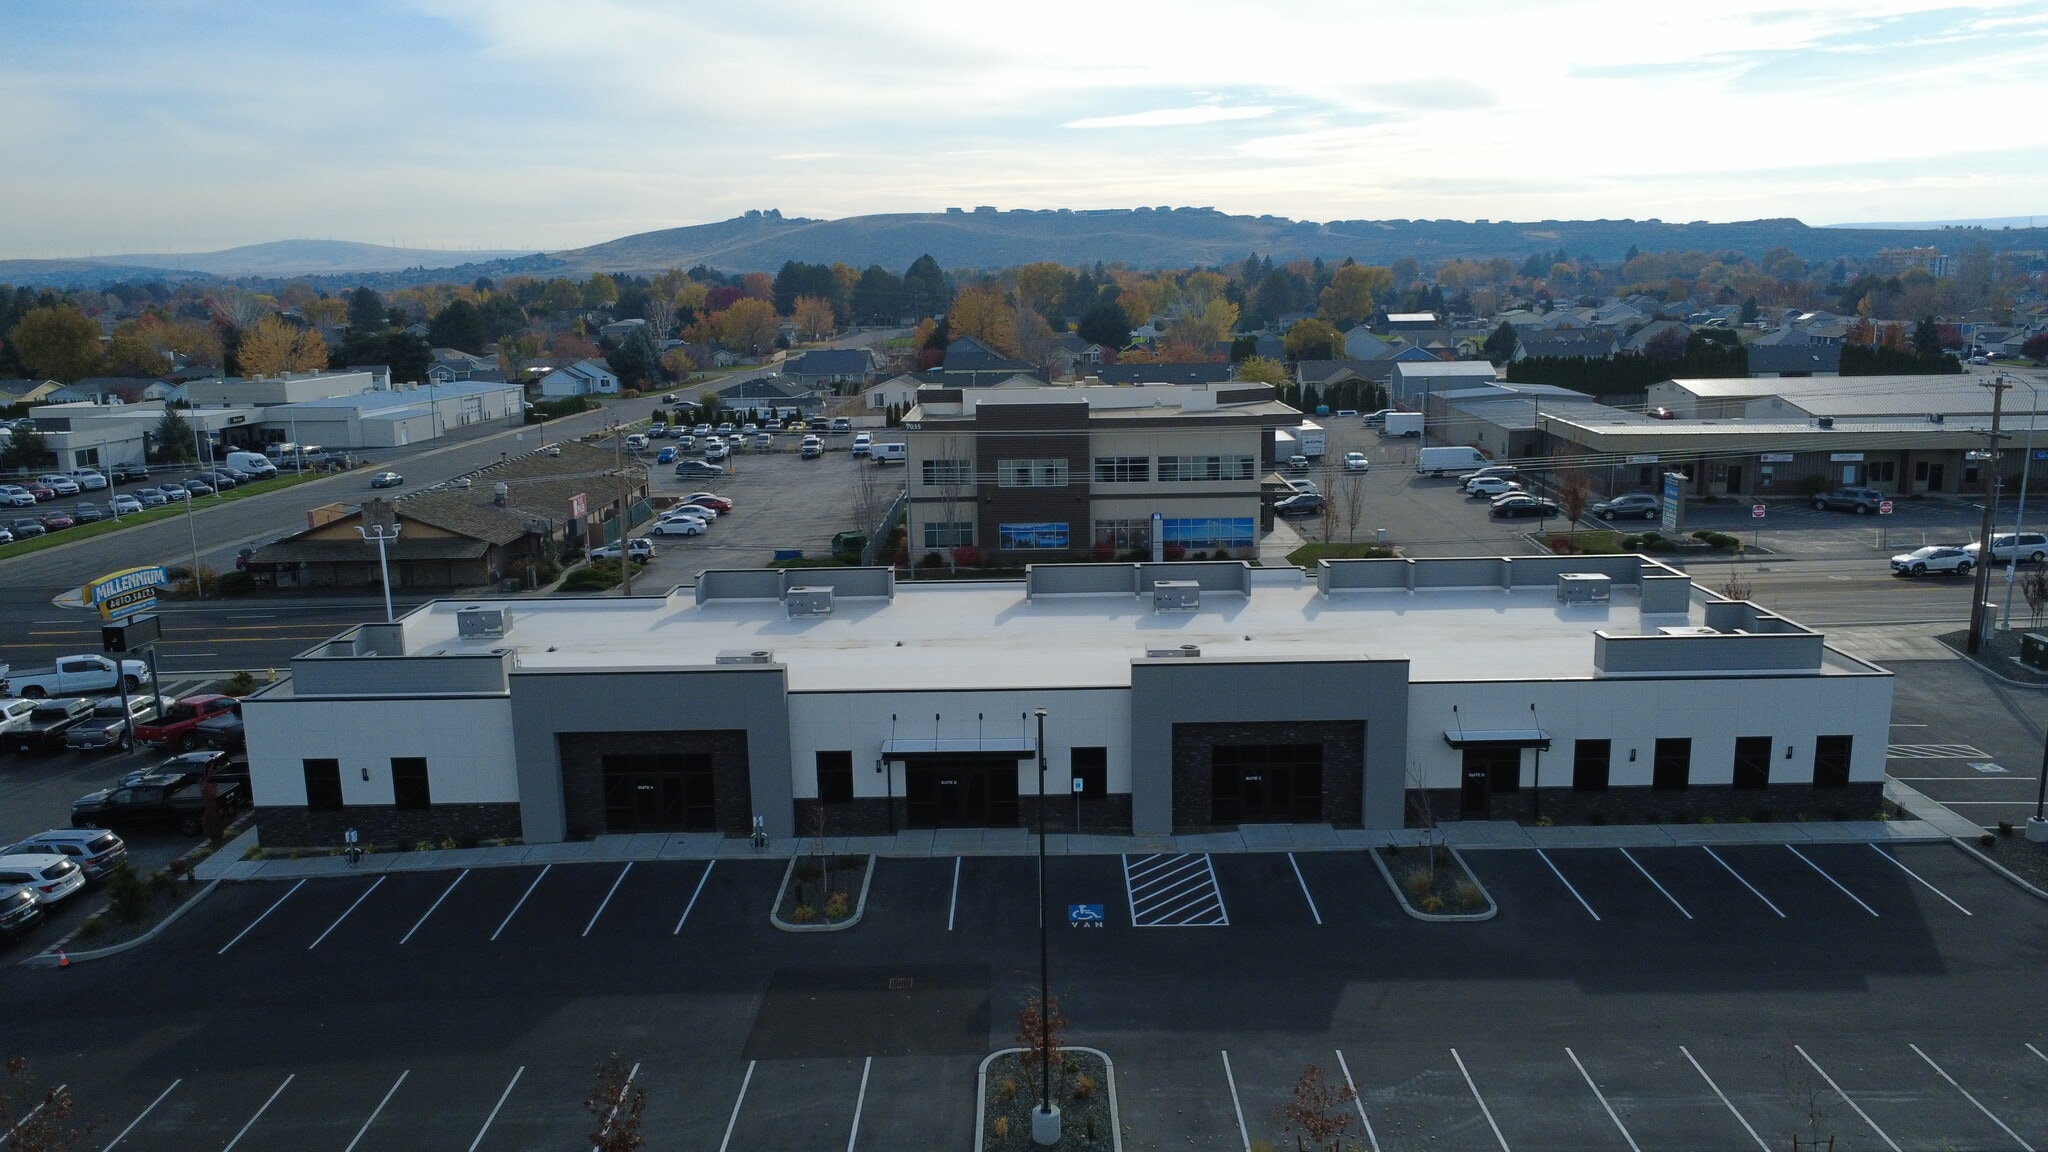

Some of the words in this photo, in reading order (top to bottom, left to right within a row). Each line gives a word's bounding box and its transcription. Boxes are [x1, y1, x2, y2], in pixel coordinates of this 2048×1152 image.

[96, 569, 165, 602] MILLENNIUM
[110, 595, 132, 609] AUTO
[132, 588, 155, 602] SALES
